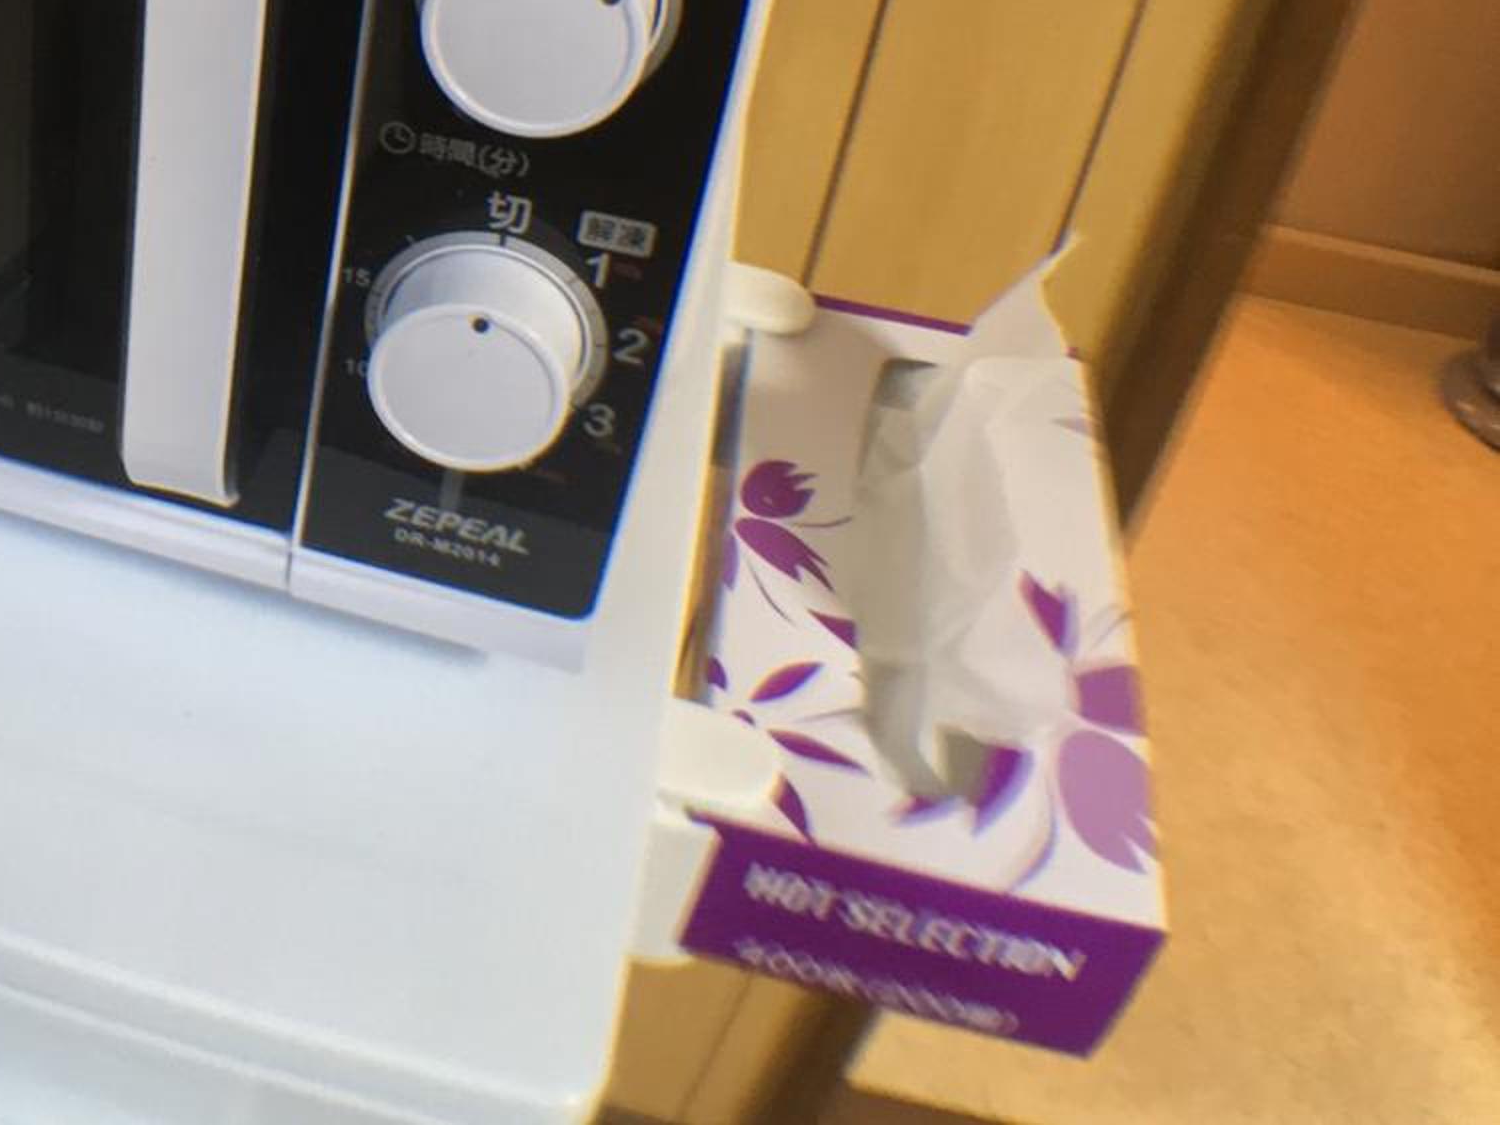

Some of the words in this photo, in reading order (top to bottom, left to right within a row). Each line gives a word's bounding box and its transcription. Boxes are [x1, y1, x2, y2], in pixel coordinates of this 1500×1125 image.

[420, 133, 530, 178] 時間(分)
[487, 190, 532, 234] 切
[585, 252, 610, 289] 1
[613, 327, 648, 365] 2
[583, 403, 616, 437] 3
[384, 498, 530, 556] ZEPEAL
[743, 861, 835, 921] HOT
[838, 888, 1088, 982] SELECTION
